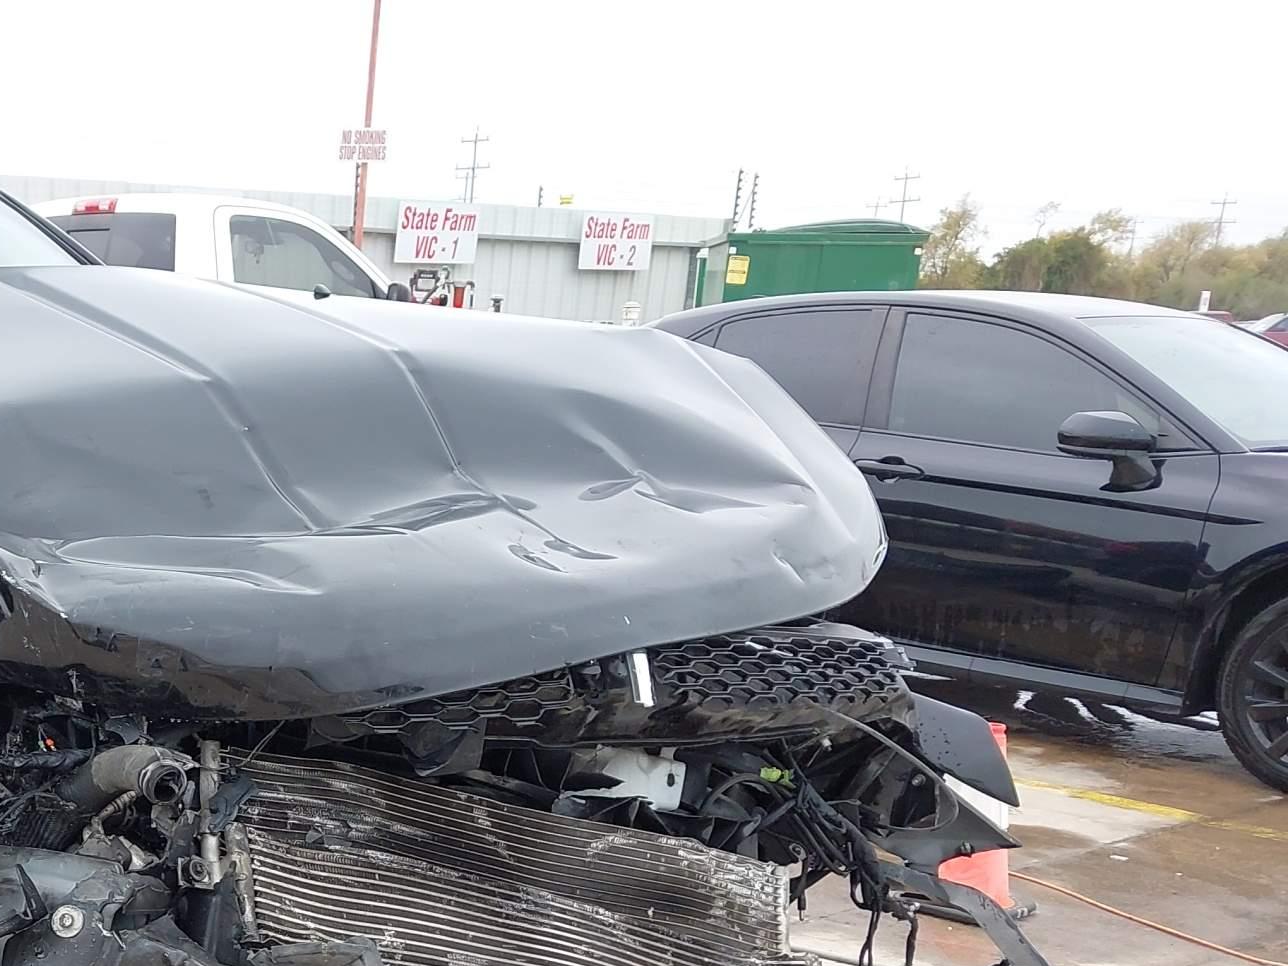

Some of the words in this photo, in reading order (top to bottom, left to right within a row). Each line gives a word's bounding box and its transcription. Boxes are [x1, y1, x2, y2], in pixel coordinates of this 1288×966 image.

[342, 130, 352, 144] NO
[354, 130, 386, 144] SMOKING
[339, 146, 356, 160] STOP
[358, 146, 386, 160] ENGINES
[402, 206, 439, 230] State
[442, 208, 476, 231] Farm
[585, 216, 617, 239] State
[620, 218, 650, 239] Farm
[415, 235, 438, 259] VIC
[451, 237, 459, 259] 1
[596, 244, 617, 266] VIC
[626, 245, 637, 266] 2
